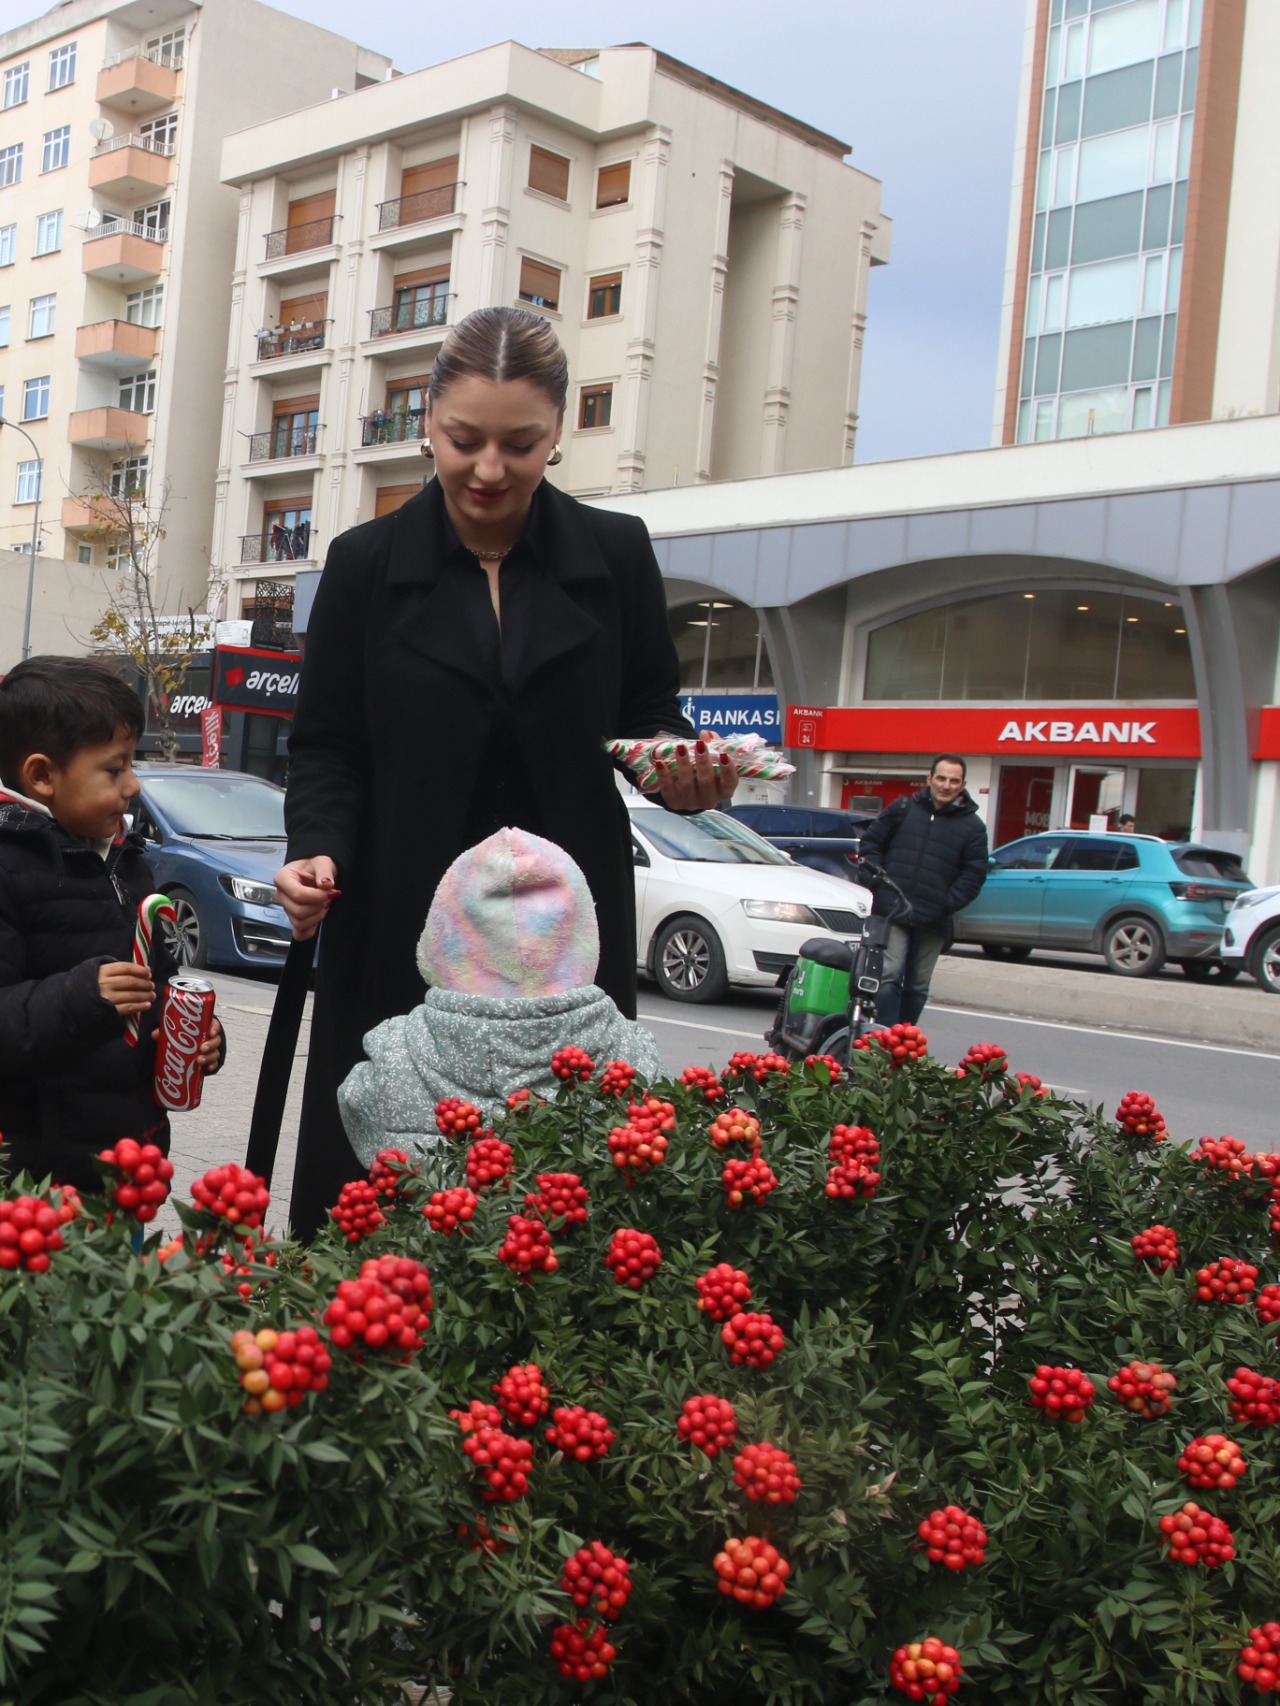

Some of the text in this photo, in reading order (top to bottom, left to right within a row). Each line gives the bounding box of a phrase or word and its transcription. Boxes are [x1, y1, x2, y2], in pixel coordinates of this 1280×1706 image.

[246, 670, 299, 697] arçeli
[793, 708, 823, 718] AKBANK
[997, 721, 1158, 743] AKBANK
[154, 987, 205, 1112] Coca-Cola
